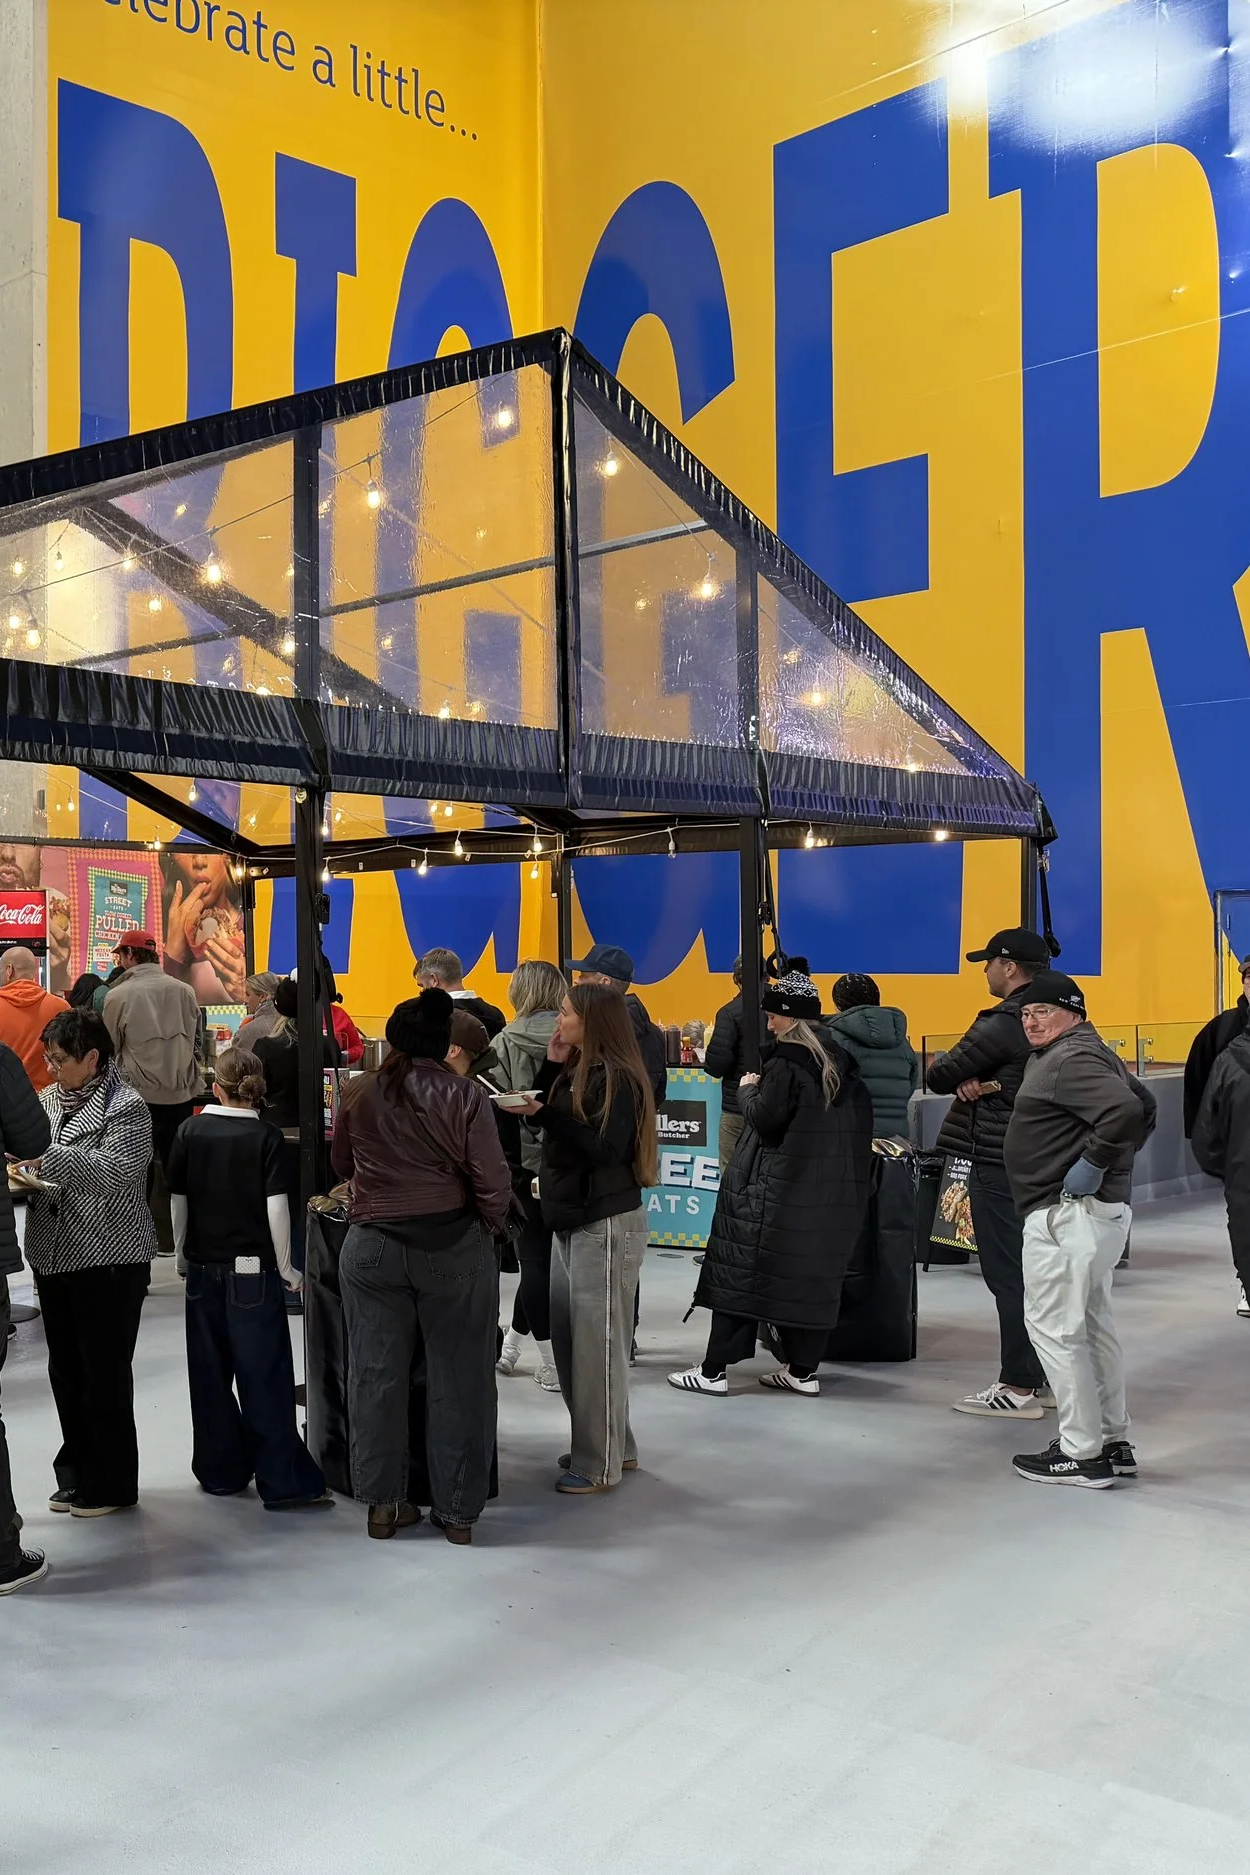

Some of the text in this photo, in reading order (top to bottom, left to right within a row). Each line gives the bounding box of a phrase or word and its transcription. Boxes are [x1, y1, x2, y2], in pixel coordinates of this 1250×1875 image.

[312, 45, 336, 88] a
[349, 44, 478, 141] little...
[104, 896, 132, 908] STREET
[95, 914, 140, 932] PULLED
[647, 1193, 701, 1215] ATS
[1049, 1461, 1079, 1473] HOKA
